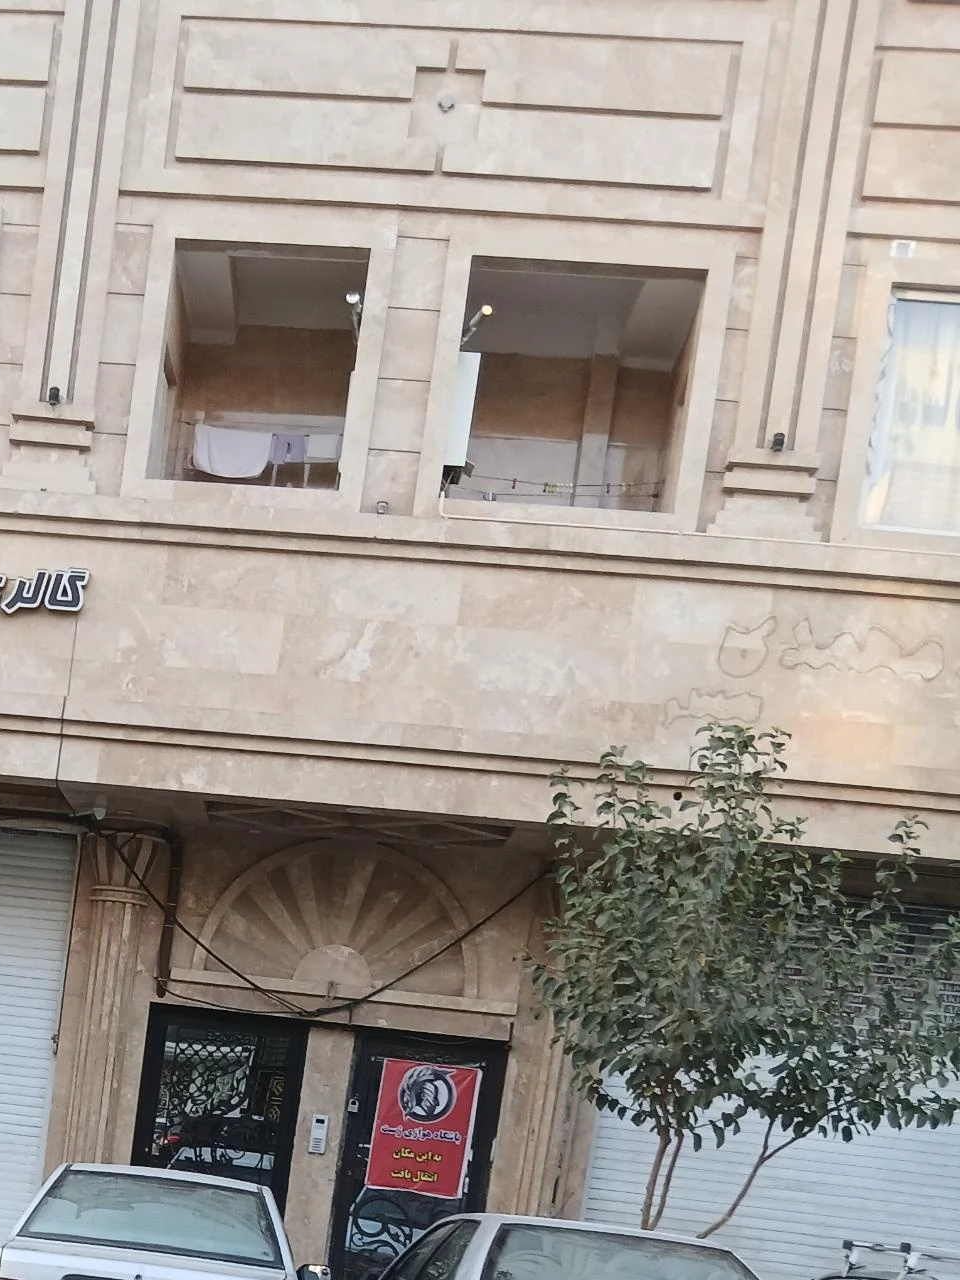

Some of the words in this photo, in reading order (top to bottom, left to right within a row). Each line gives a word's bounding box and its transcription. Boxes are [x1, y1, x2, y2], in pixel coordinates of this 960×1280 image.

[392, 1147, 415, 1159] مکان
[416, 1151, 432, 1163] این
[391, 1167, 412, 1179] یافت
[412, 1170, 438, 1183] انتقال
